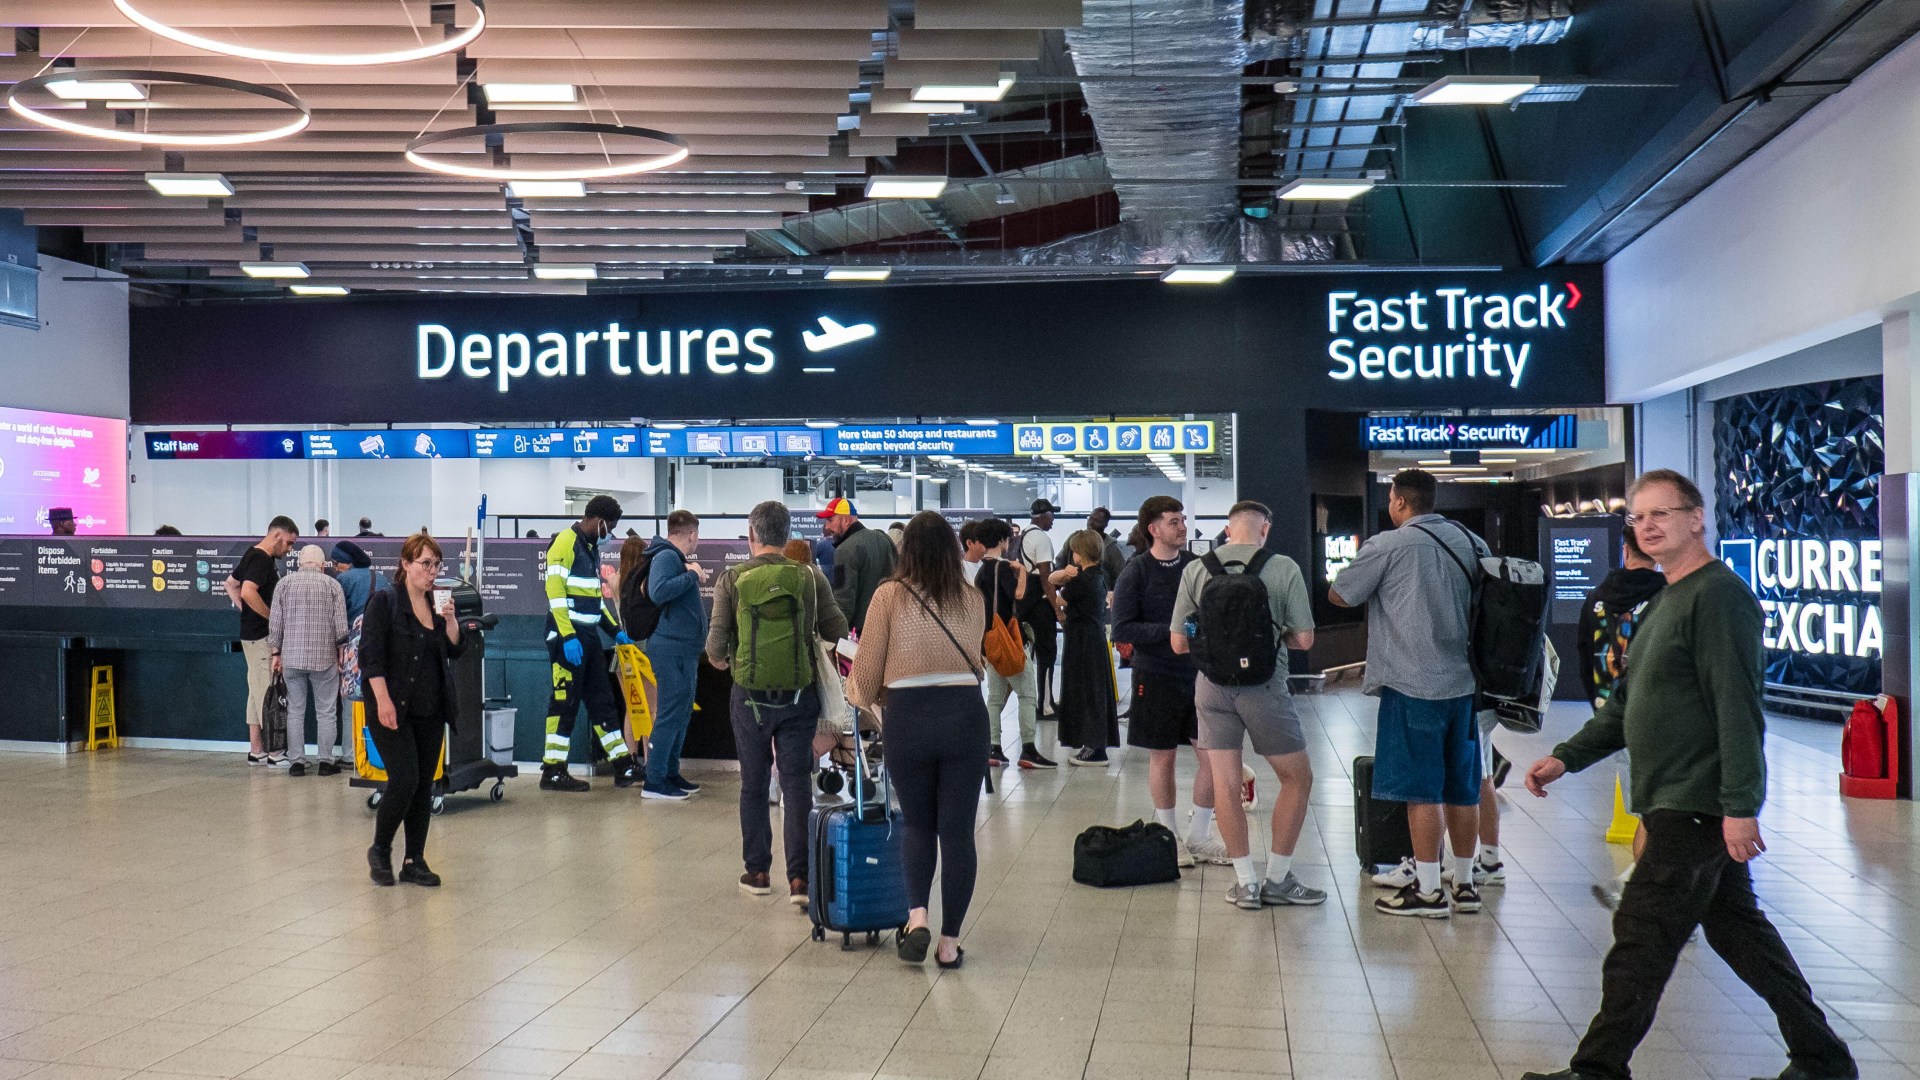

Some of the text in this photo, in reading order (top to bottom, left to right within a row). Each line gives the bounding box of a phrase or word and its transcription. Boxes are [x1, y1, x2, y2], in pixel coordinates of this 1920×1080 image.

[1328, 284, 1566, 333] Fast Track
[417, 322, 775, 392] Departures
[1328, 333, 1531, 388] Security
[838, 429, 996, 440] More than 50 shops and restaurants
[1369, 424, 1529, 444] Fast Track Security
[154, 440, 199, 451] Staff lane
[838, 440, 953, 452] to explore beyond Security
[1554, 539, 1589, 547] Fast Track
[38, 546, 64, 556] Dispose
[1554, 546, 1584, 554] Security
[38, 556, 80, 565] of forbidden
[286, 559, 295, 568] of
[38, 566, 58, 574] items
